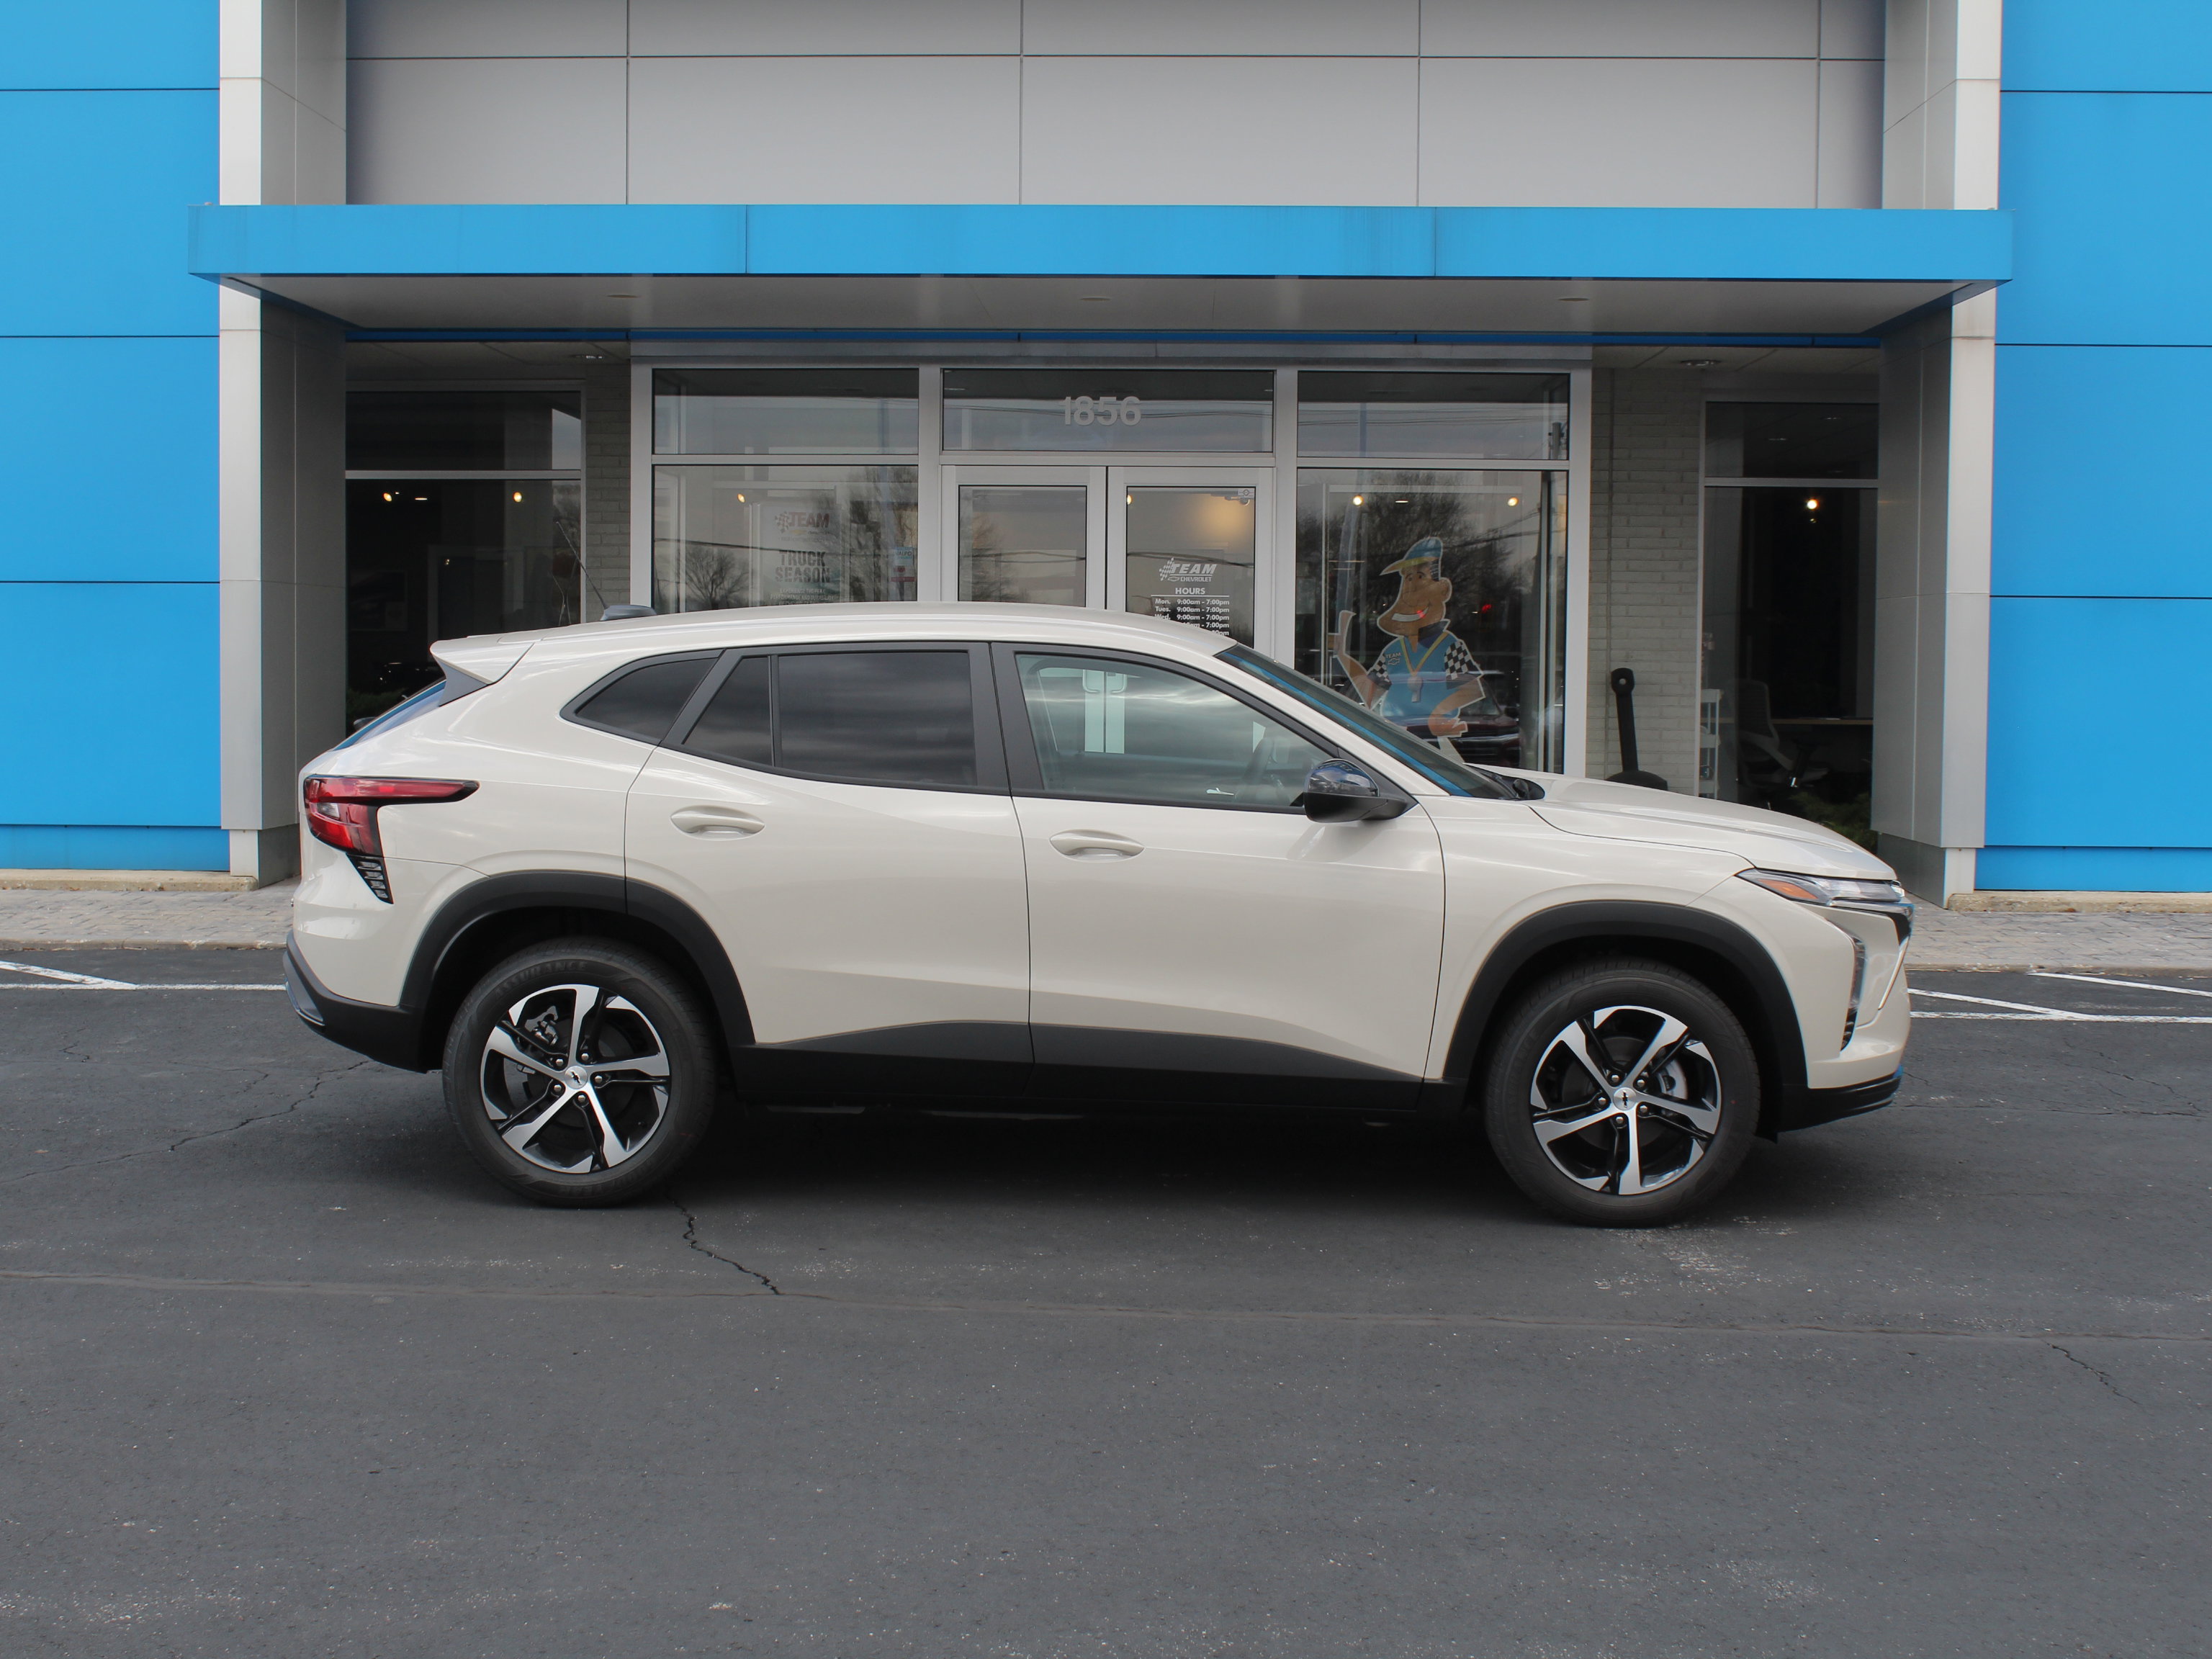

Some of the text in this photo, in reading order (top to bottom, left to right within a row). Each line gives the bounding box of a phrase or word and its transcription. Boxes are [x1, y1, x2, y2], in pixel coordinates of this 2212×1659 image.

[1058, 395, 1141, 426] 1856
[788, 511, 830, 528] TEAM
[779, 551, 827, 567] TRUCK
[775, 567, 830, 583] SEASON
[1170, 564, 1217, 574] TEAM
